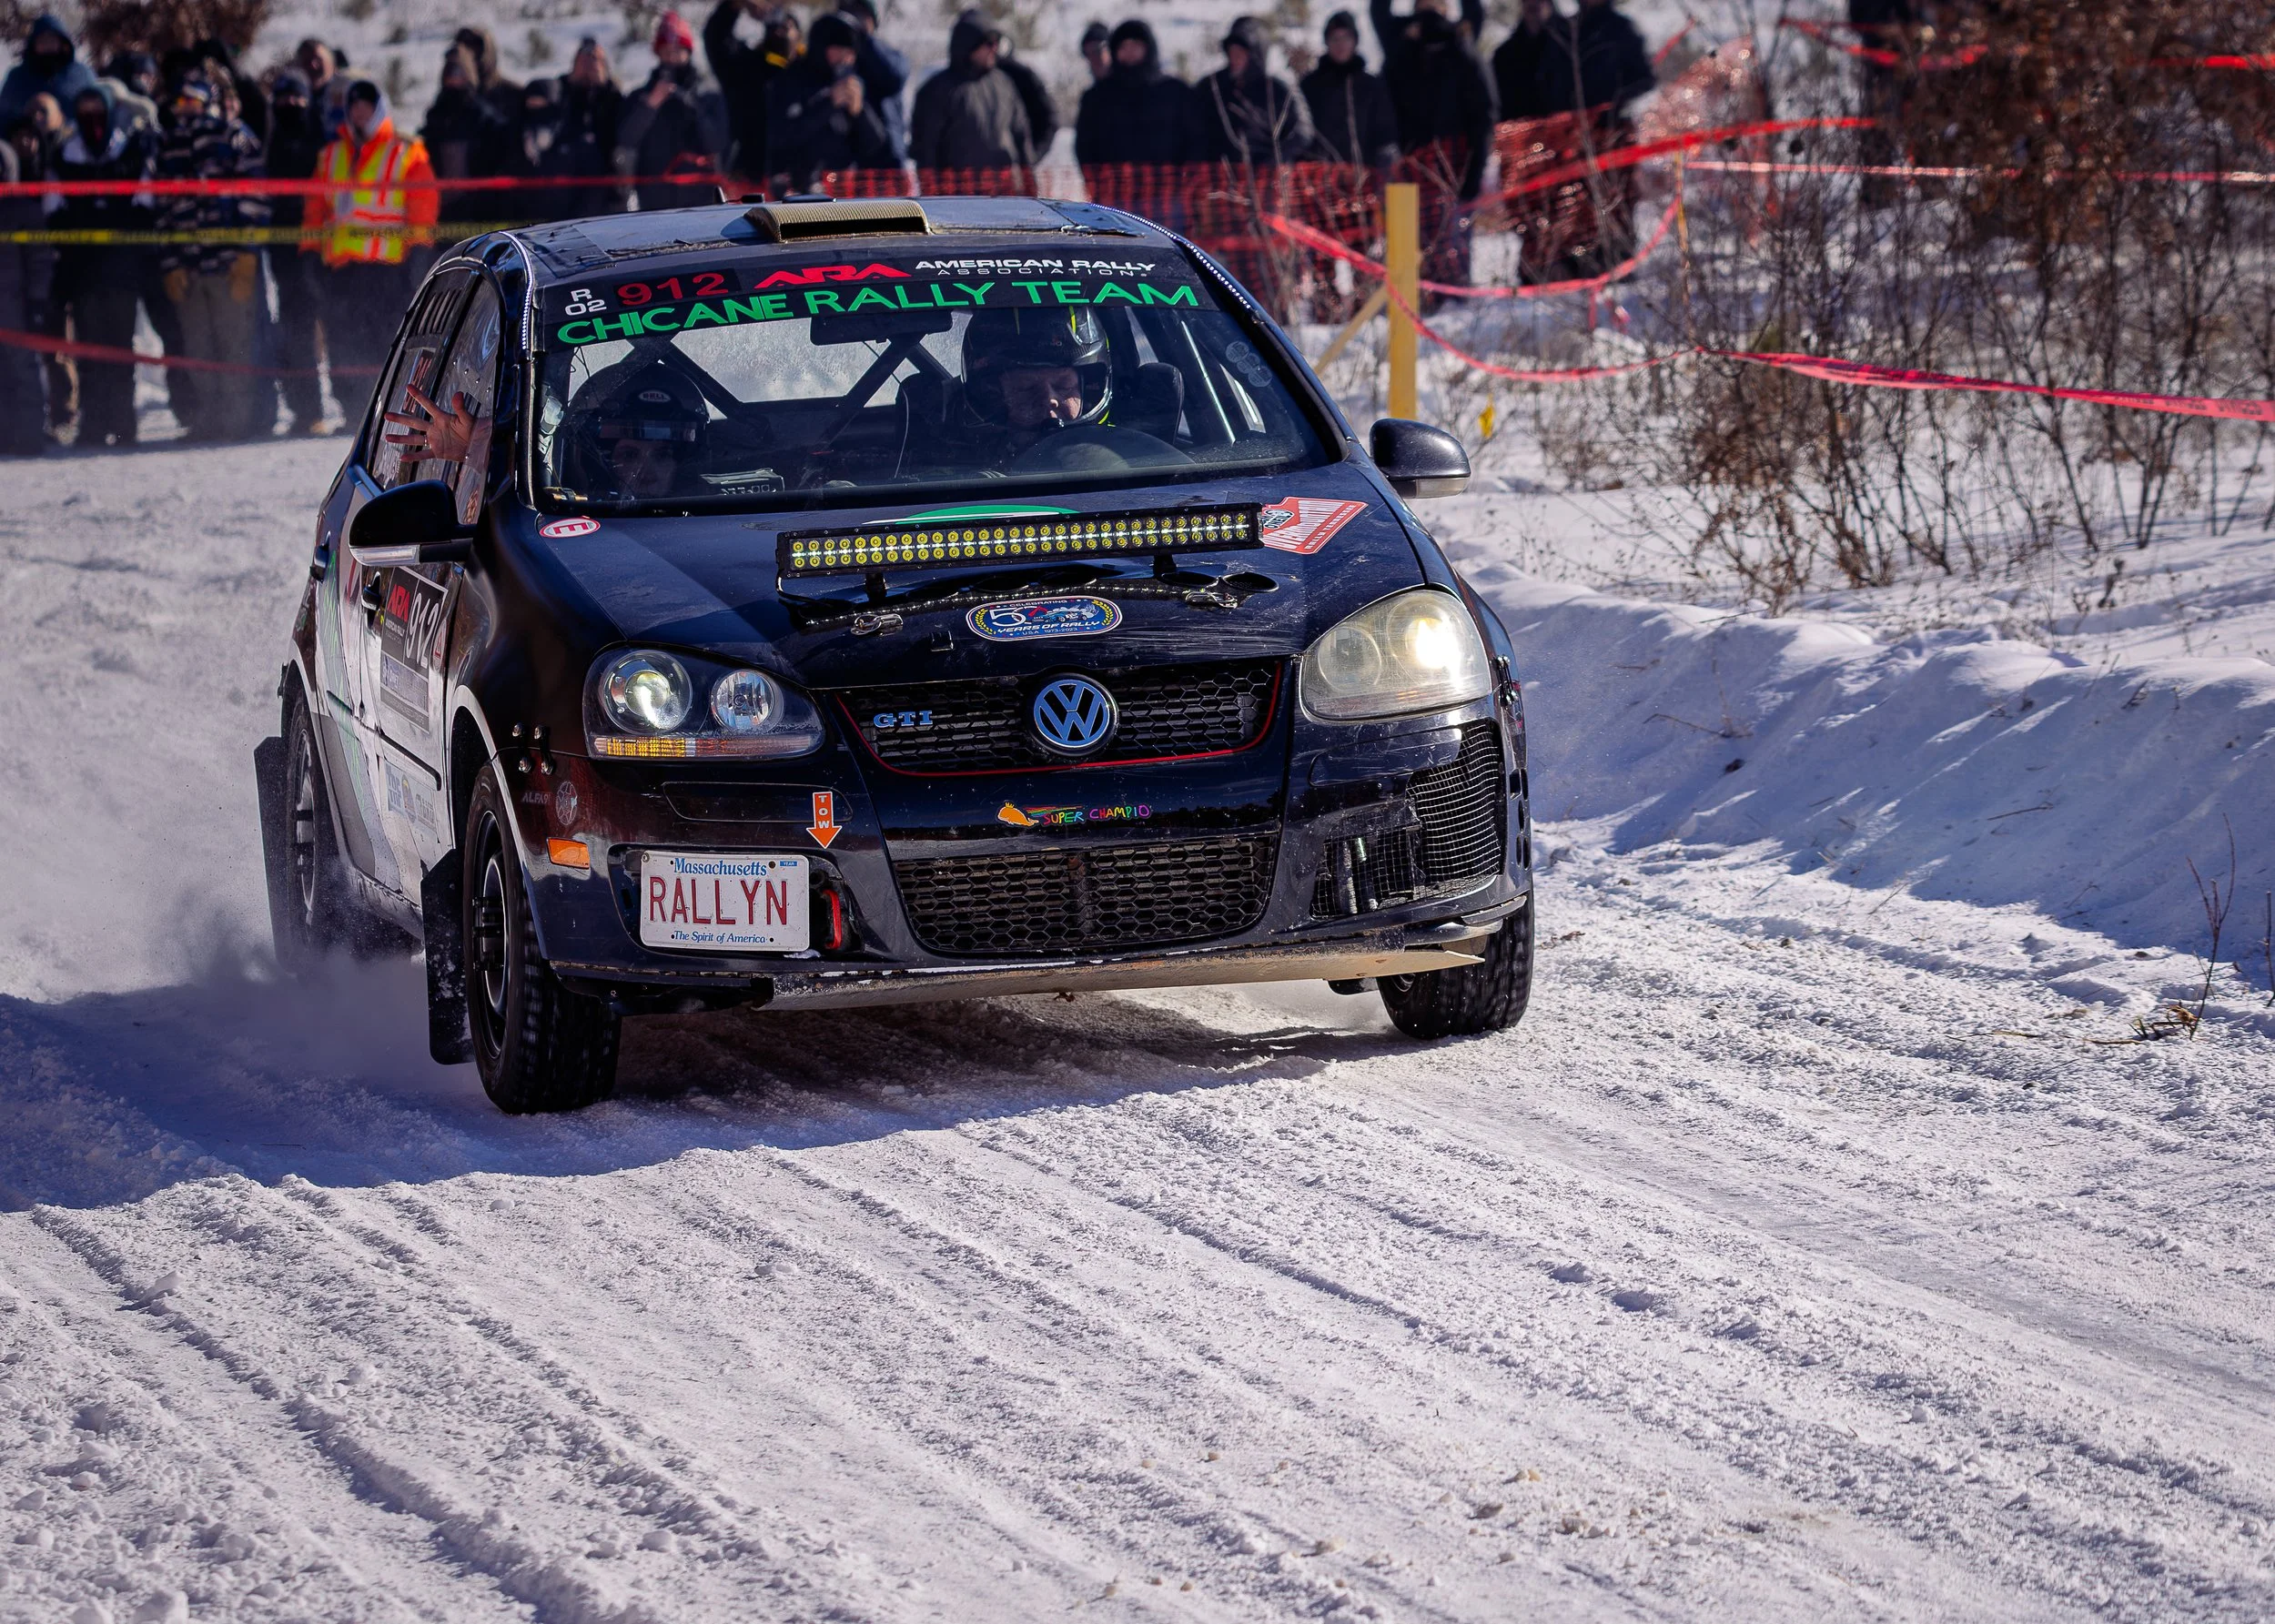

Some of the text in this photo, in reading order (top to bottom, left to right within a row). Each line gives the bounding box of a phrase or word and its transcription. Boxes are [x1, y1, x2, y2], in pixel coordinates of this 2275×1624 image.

[915, 259, 1156, 271] AMERICAN RALLY
[937, 267, 1135, 277] ASSOCIATION
[754, 263, 912, 289] ARA
[571, 288, 592, 302] R
[617, 273, 729, 306] 912
[557, 281, 1199, 344] CHICANE RALLY TEAM
[1009, 600, 1068, 608] CELEBRATING
[406, 592, 440, 670] 912
[997, 624, 1041, 633] YEARS
[1060, 620, 1100, 629] RALLY
[873, 711, 933, 728] GTI
[818, 795, 829, 829] TOW
[1043, 811, 1085, 825] SUPER
[673, 858, 767, 876] Massachusetts
[649, 876, 787, 925] RALLYN
[673, 930, 766, 943] The Spirit of America
